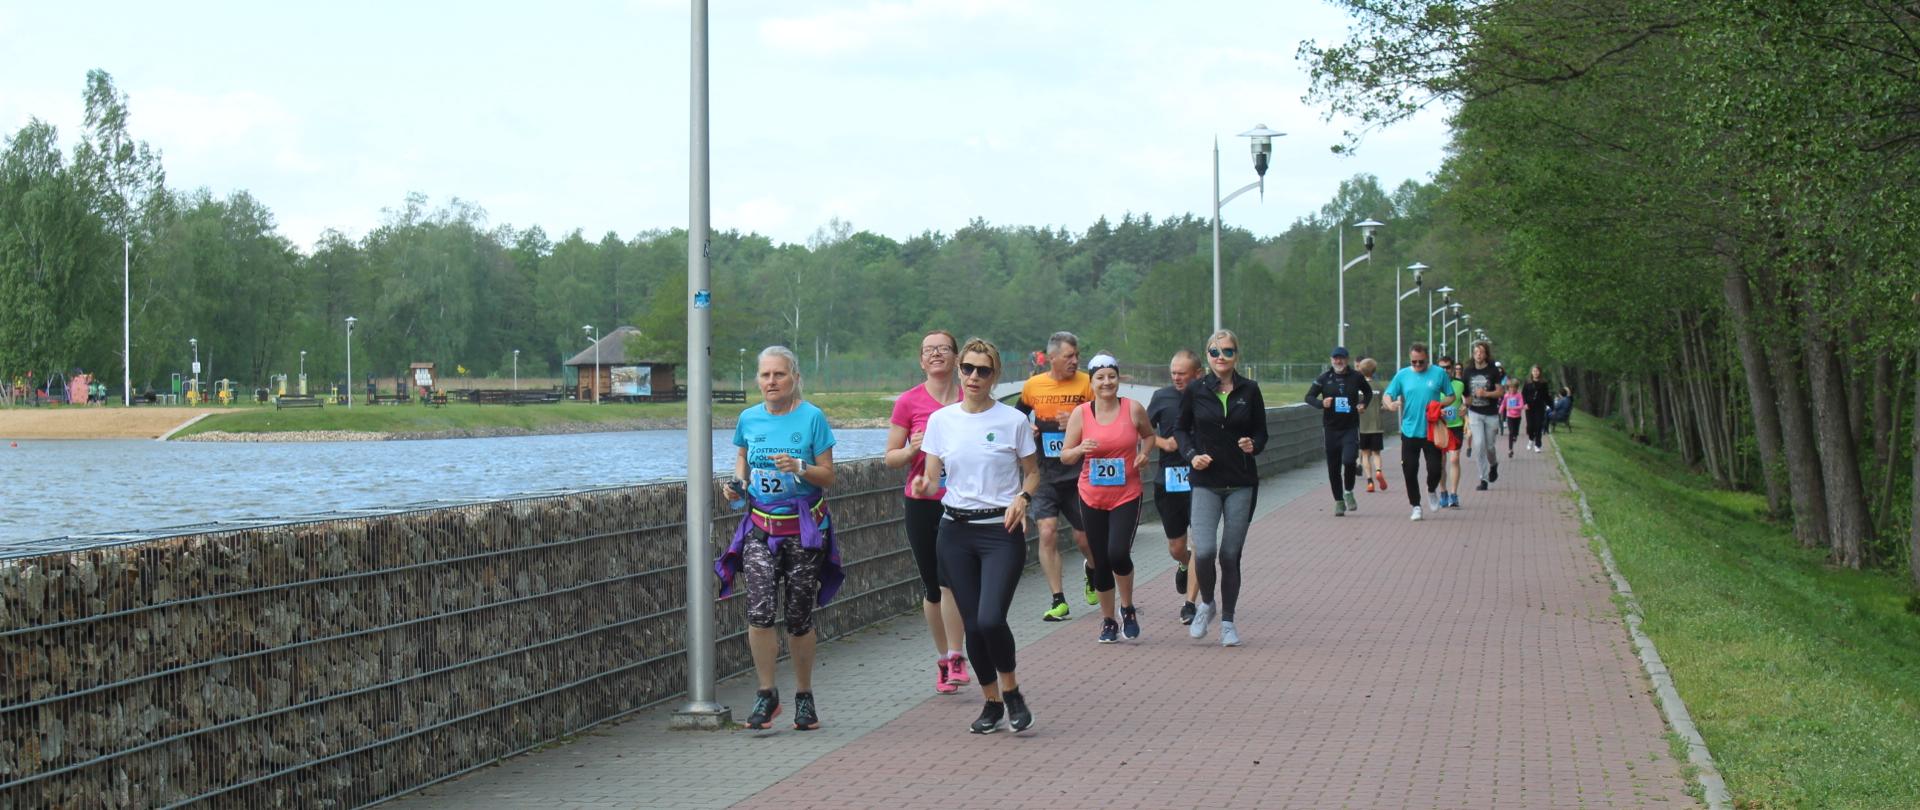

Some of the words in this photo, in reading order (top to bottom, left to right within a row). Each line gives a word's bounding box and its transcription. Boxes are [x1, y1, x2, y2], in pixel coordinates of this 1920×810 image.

[1050, 440, 1064, 451] 60
[1098, 465, 1116, 477] 20
[761, 478, 783, 493] 52
